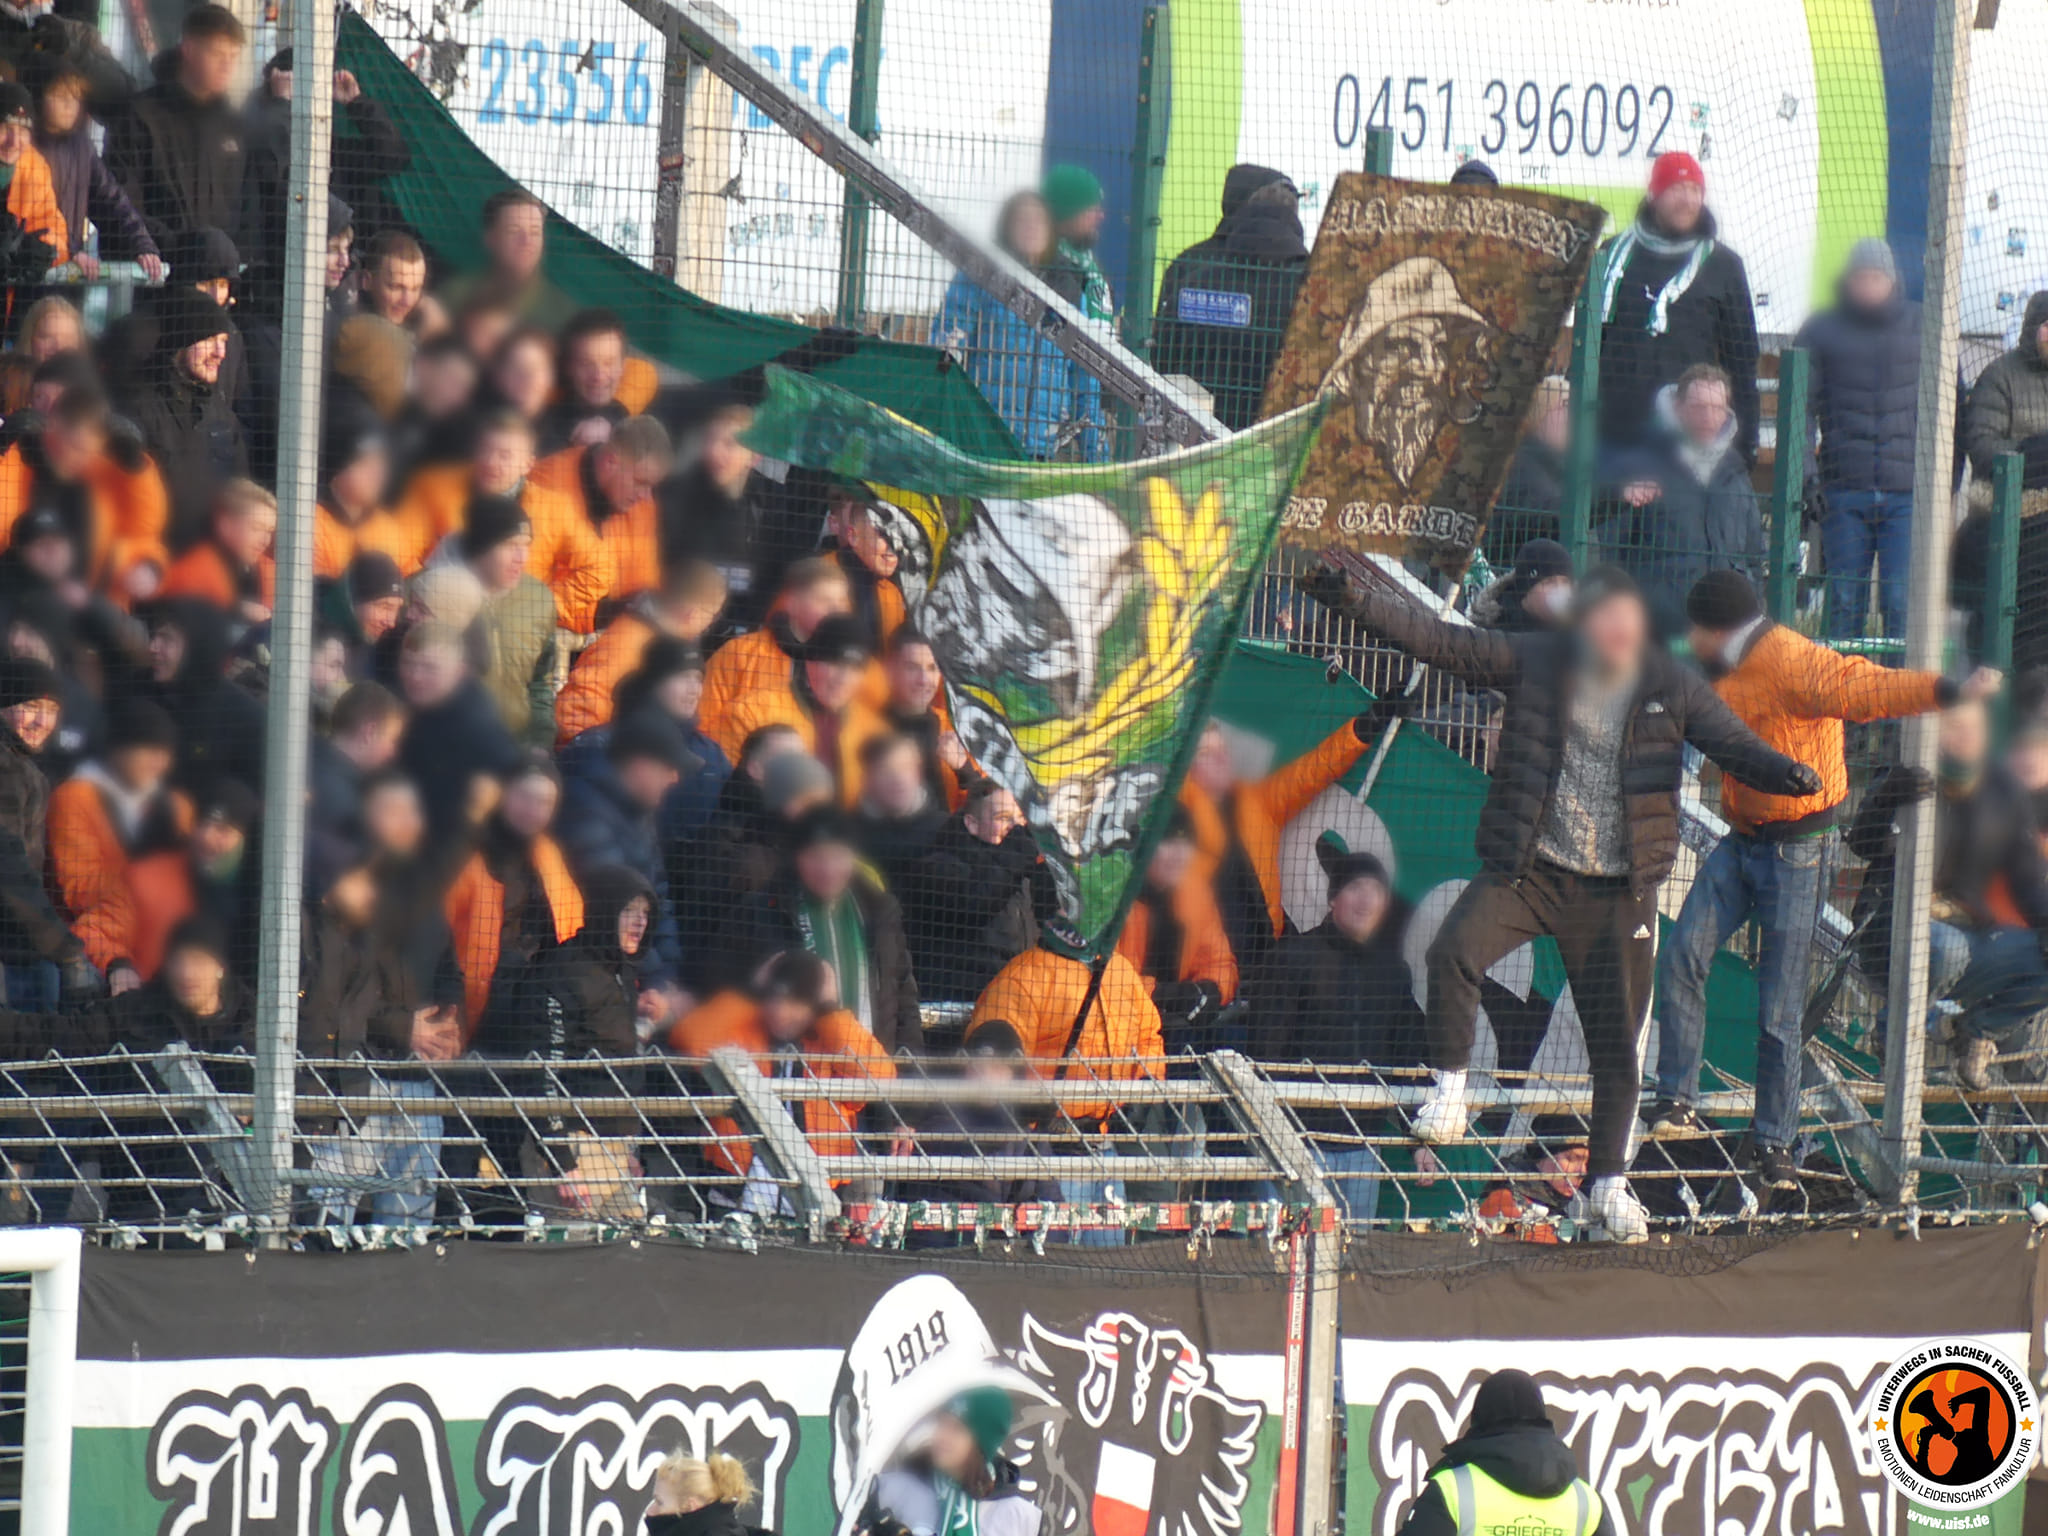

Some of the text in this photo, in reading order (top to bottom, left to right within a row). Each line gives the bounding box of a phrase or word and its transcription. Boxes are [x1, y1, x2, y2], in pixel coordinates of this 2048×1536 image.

[477, 38, 652, 127] 23556
[1333, 73, 1674, 157] 0451 396092
[883, 1309, 950, 1387] 1919
